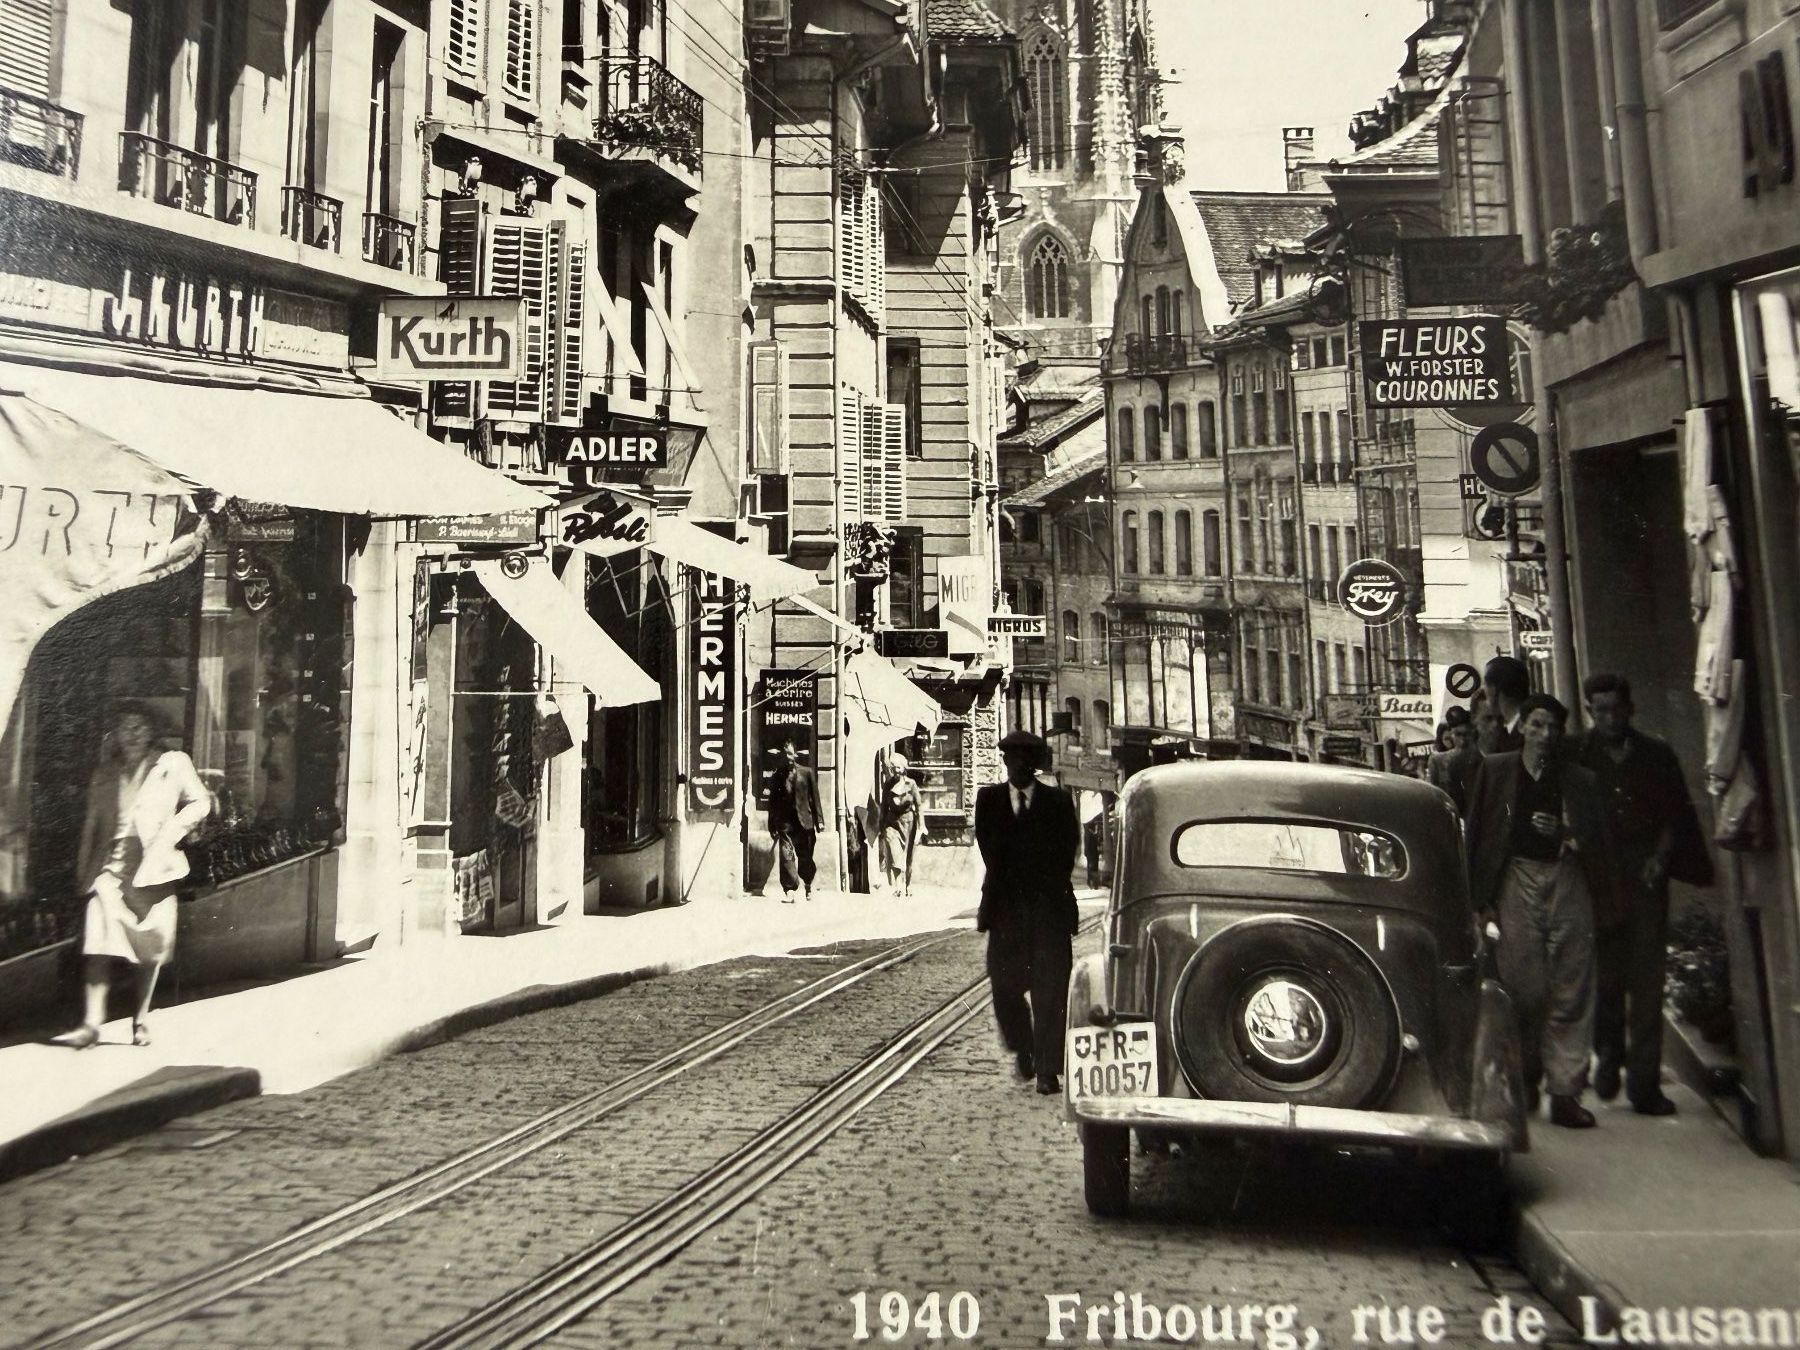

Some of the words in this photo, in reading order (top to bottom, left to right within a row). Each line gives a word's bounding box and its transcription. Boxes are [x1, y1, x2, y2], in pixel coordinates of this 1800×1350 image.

[391, 316, 511, 369] Kurth
[1380, 326, 1486, 358] FLEURS
[1376, 379, 1499, 403] COURONNES
[565, 437, 658, 462] ADLER
[1346, 582, 1399, 616] Frey
[698, 569, 725, 771] HERMES
[765, 711, 813, 726] HERMES
[1381, 698, 1433, 713] Bata
[1095, 1030, 1128, 1062] FR
[1074, 1061, 1152, 1097] 10057
